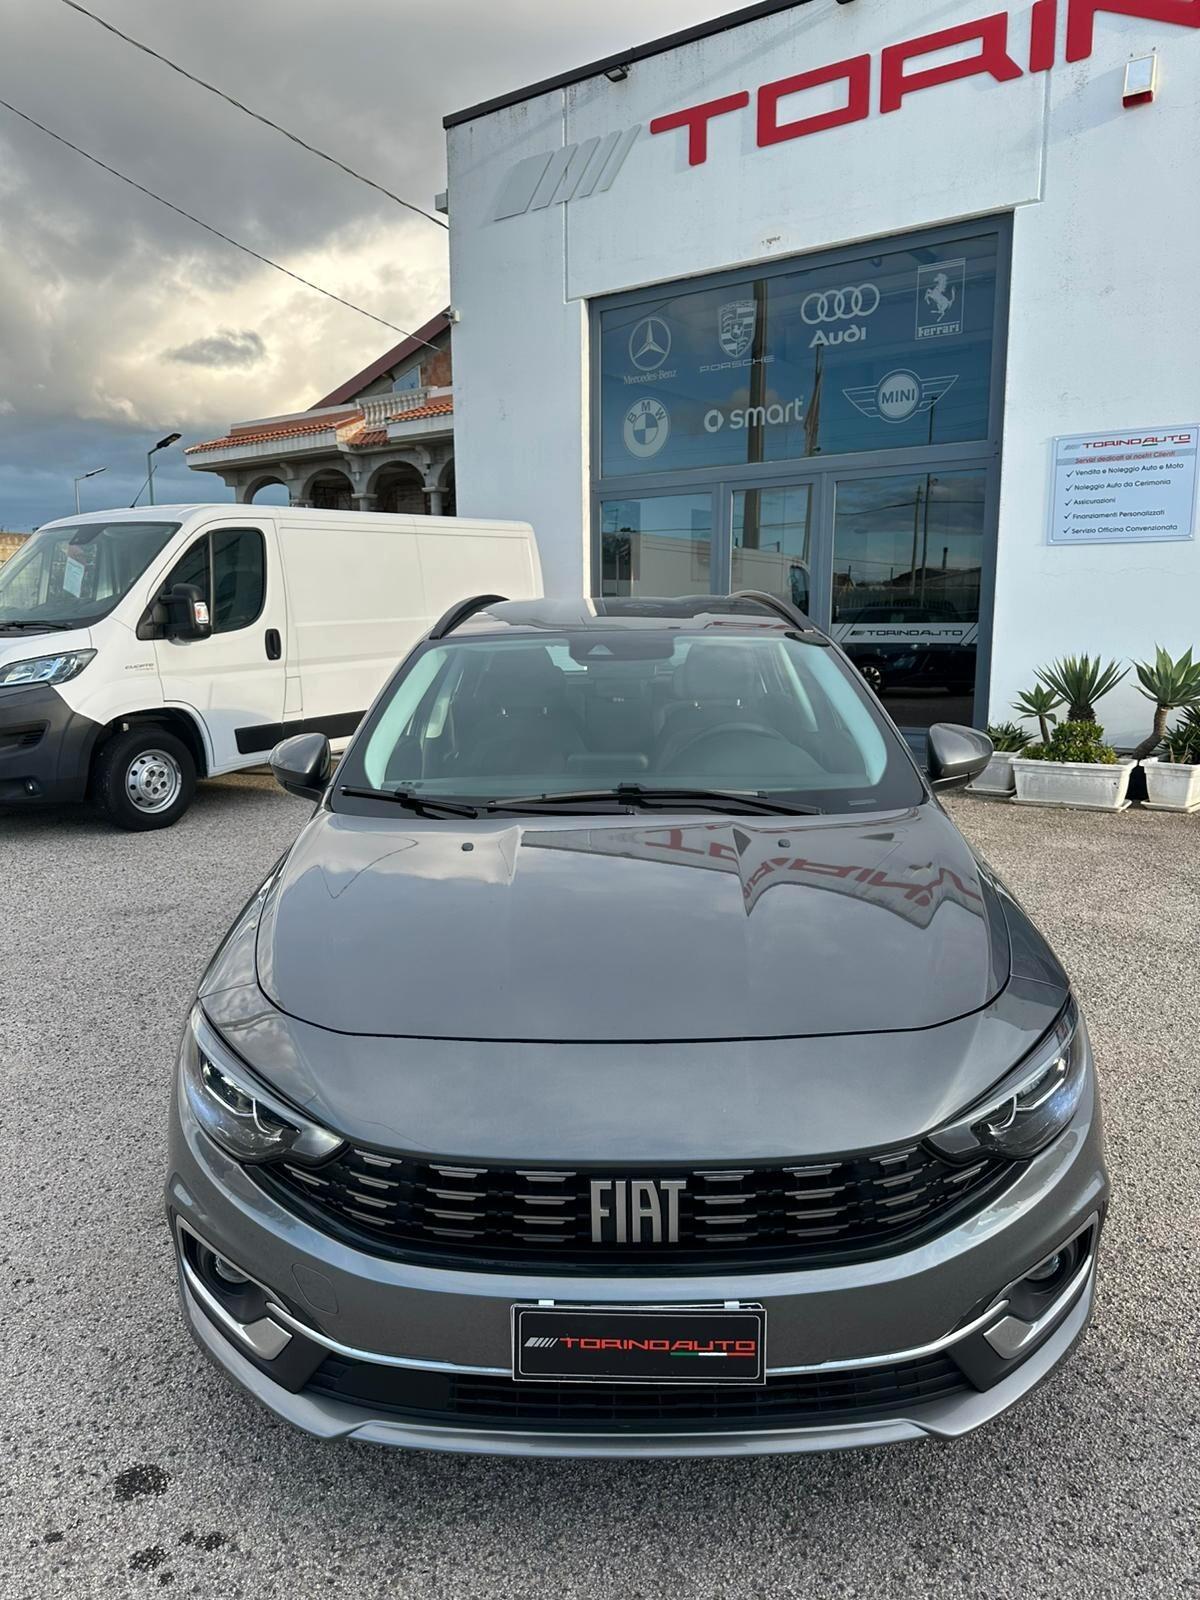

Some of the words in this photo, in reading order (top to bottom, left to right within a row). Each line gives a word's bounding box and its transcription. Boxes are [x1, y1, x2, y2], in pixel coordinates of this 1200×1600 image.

[808, 324, 867, 348] Audi
[918, 324, 960, 338] Ferrari
[700, 354, 775, 373] PORSCHE
[624, 370, 677, 385] Mercedes-Benz
[881, 388, 916, 404] MINI
[626, 401, 667, 424] BMW
[729, 398, 804, 430] smart
[1082, 434, 1191, 449] TORINOAUTO
[1153, 450, 1176, 458] Clienti
[1075, 469, 1101, 477] Vendita
[1108, 465, 1140, 475] Noleggio
[1141, 464, 1158, 472] Auto
[1165, 462, 1184, 470] Moto
[1074, 482, 1105, 492] Noleggio
[1106, 481, 1122, 489] Auto
[1123, 480, 1134, 488] da
[1135, 478, 1171, 487] Cerimonia
[1073, 497, 1116, 506] Assicurazioni
[1072, 511, 1118, 520] Finanziamenti
[1119, 509, 1165, 518] Personalizzati
[1072, 527, 1096, 535] Servizio
[1097, 525, 1124, 534] Officina
[1125, 523, 1178, 533] Convenzionata
[867, 629, 963, 637] TORINOAUTO
[590, 1180, 687, 1243] FIAT
[559, 1337, 756, 1351] TORINOAUTO
